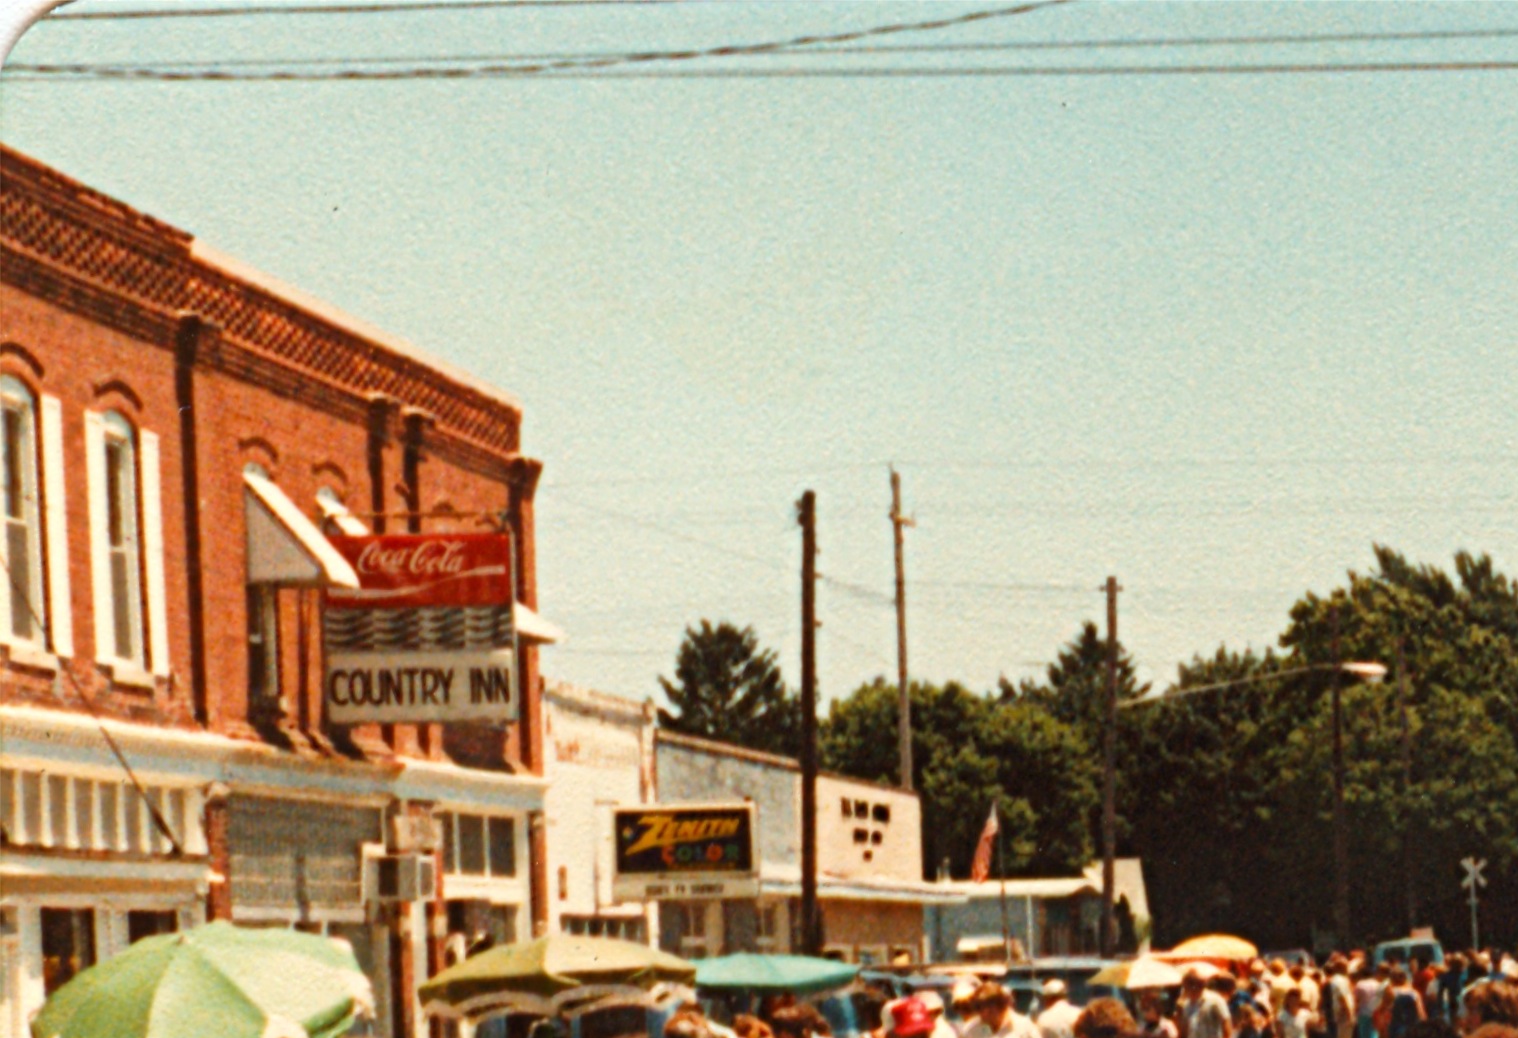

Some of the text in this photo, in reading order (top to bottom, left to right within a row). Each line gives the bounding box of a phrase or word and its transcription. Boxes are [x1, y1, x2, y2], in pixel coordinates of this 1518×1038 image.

[330, 667, 511, 706] COUNTRY INN
[625, 815, 740, 856] ZENITH
[661, 843, 740, 864] COLOR
